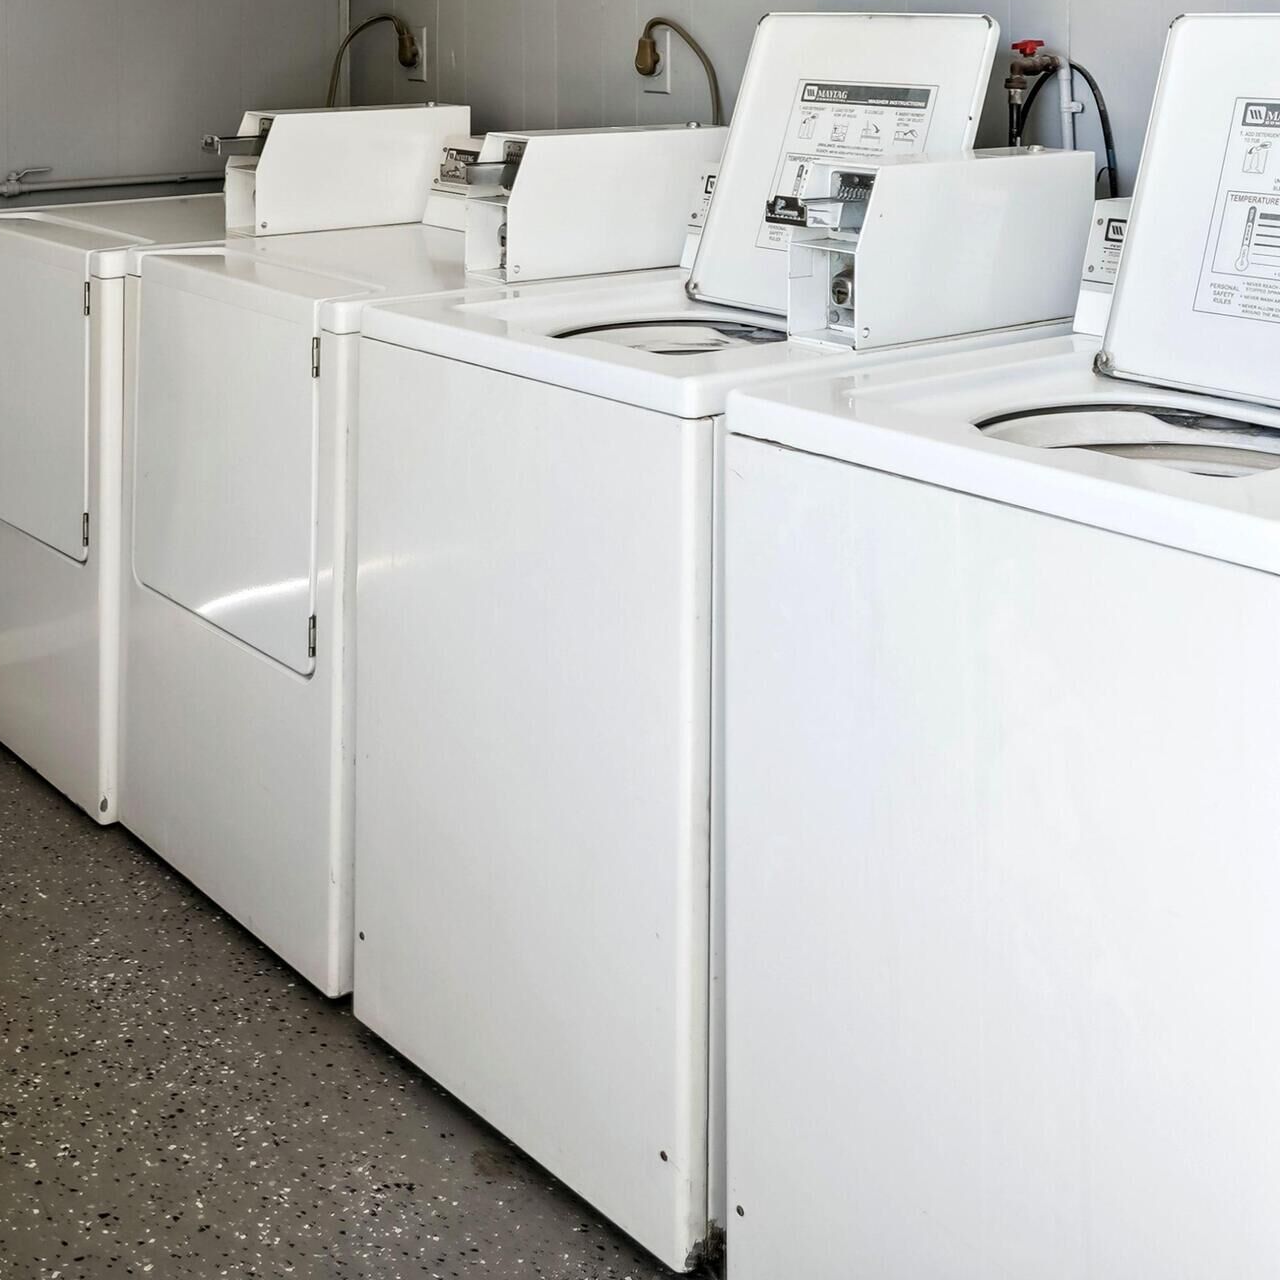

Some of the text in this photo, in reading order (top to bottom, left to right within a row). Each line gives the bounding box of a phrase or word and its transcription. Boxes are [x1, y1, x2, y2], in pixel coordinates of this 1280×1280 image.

[818, 89, 848, 99] MAYTAG
[1230, 194, 1279, 205] TEMPERATURE
[1210, 283, 1240, 291] PERSONAL
